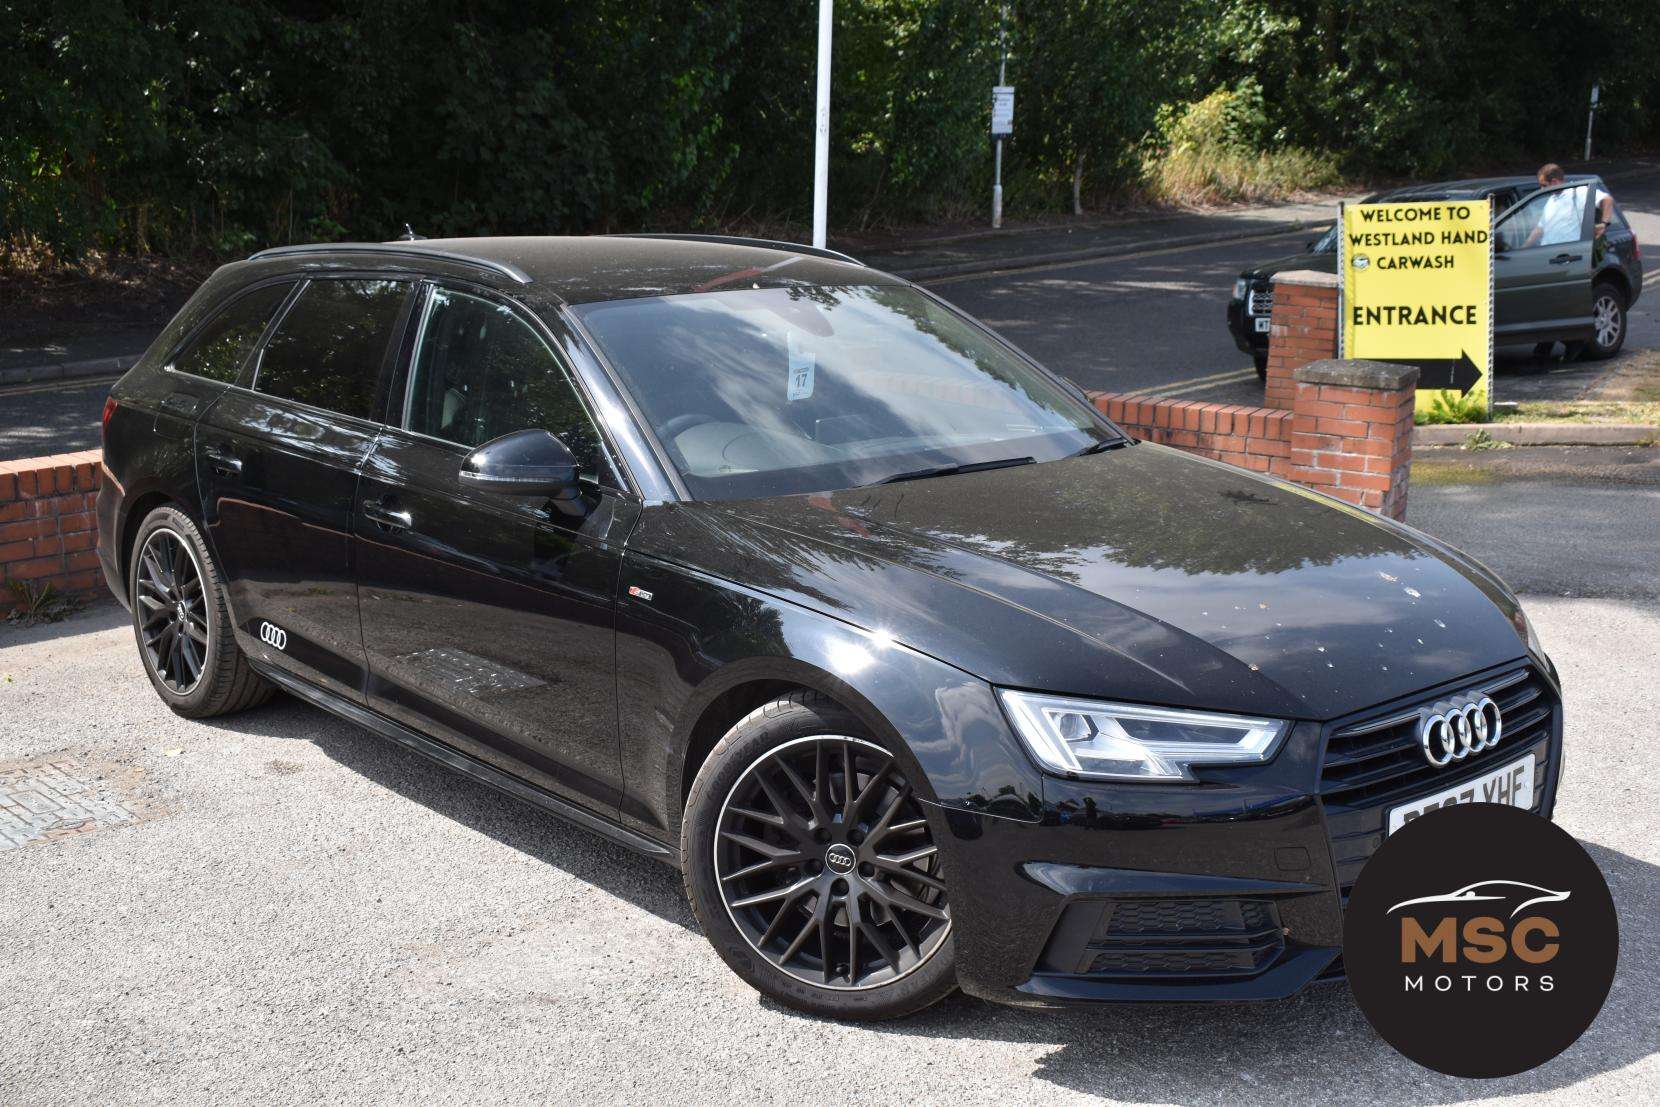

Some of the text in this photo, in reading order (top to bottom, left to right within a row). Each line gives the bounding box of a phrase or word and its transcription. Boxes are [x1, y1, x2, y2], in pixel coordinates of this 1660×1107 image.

[1360, 206, 1471, 222] WELCOME TO
[1349, 230, 1488, 247] WESTLAND HAND
[1377, 255, 1454, 270] CARWASH
[1353, 305, 1477, 325] ENTRANCE
[795, 373, 807, 387] 17
